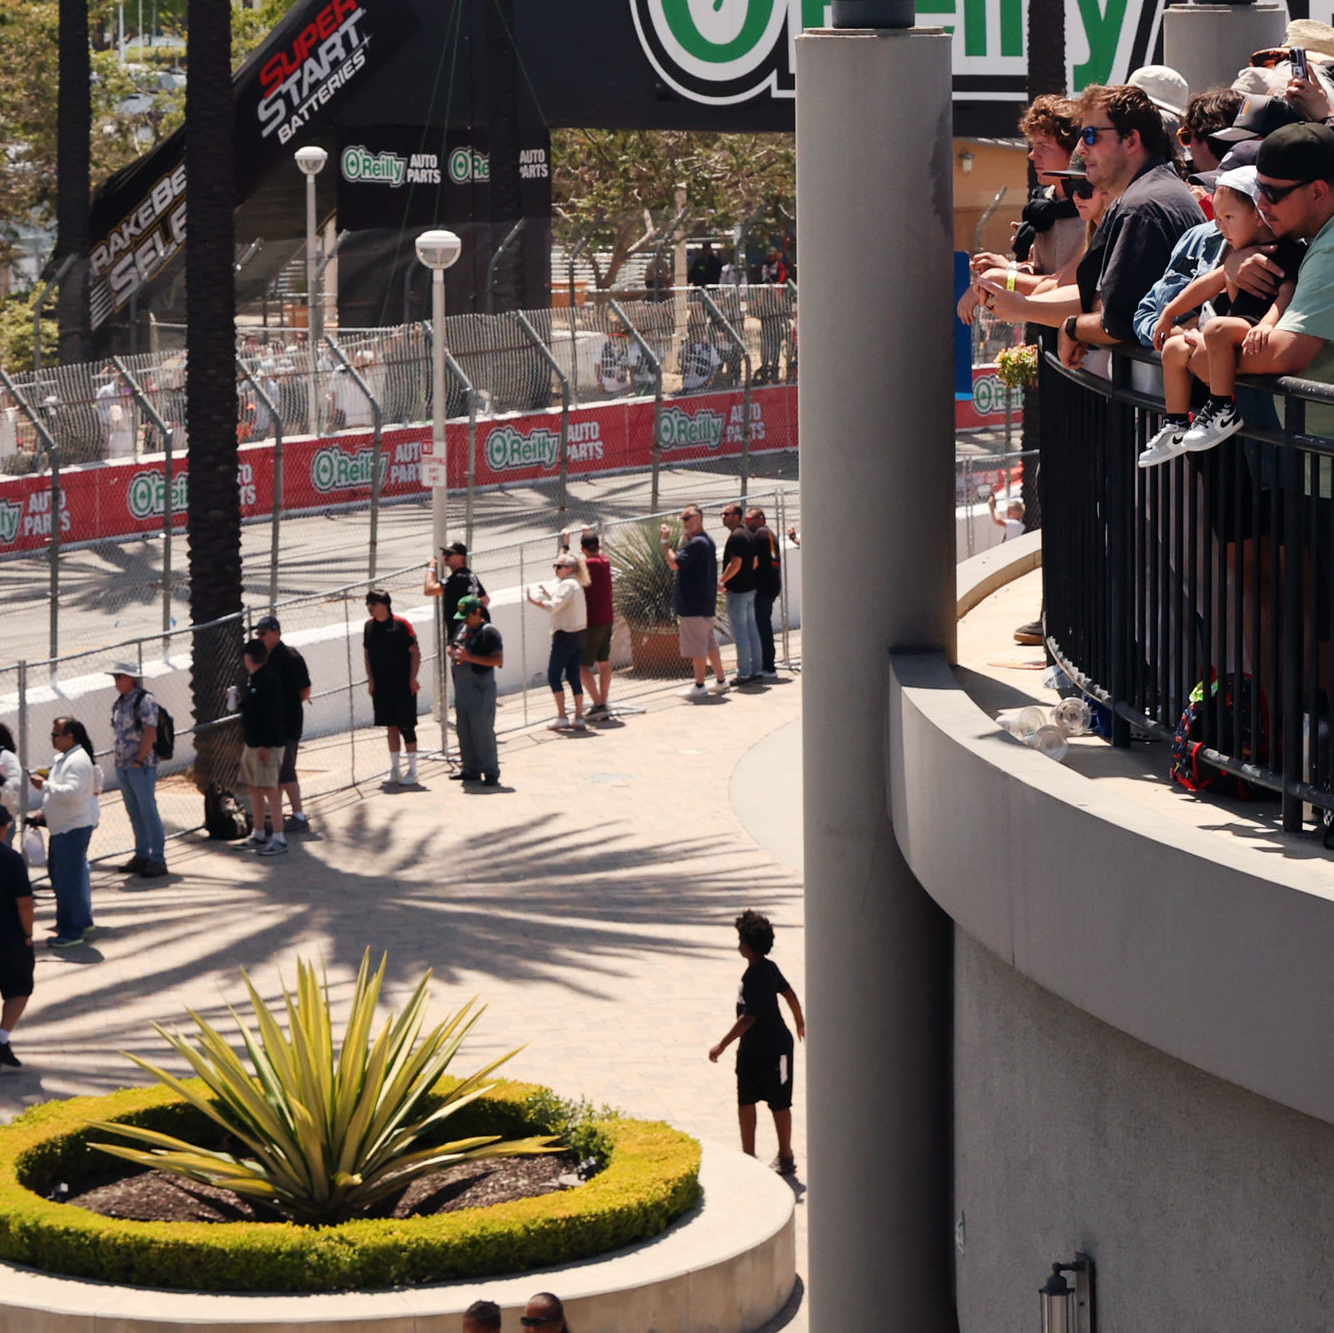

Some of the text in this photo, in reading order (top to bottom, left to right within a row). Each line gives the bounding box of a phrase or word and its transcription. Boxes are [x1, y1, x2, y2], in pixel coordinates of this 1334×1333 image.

[257, 7, 365, 139] START
[277, 49, 366, 146] BATTERIES
[345, 149, 405, 181] O'Reilly
[410, 154, 437, 169] AUTO
[519, 149, 546, 164] AUTO
[406, 169, 441, 185] PARTS
[89, 163, 187, 286] RAKEBE
[110, 200, 187, 308] SELE
[567, 421, 600, 443] AUTO
[395, 441, 422, 463] AUT
[487, 430, 558, 466] O'Reilly
[23, 510, 72, 537] PARS
